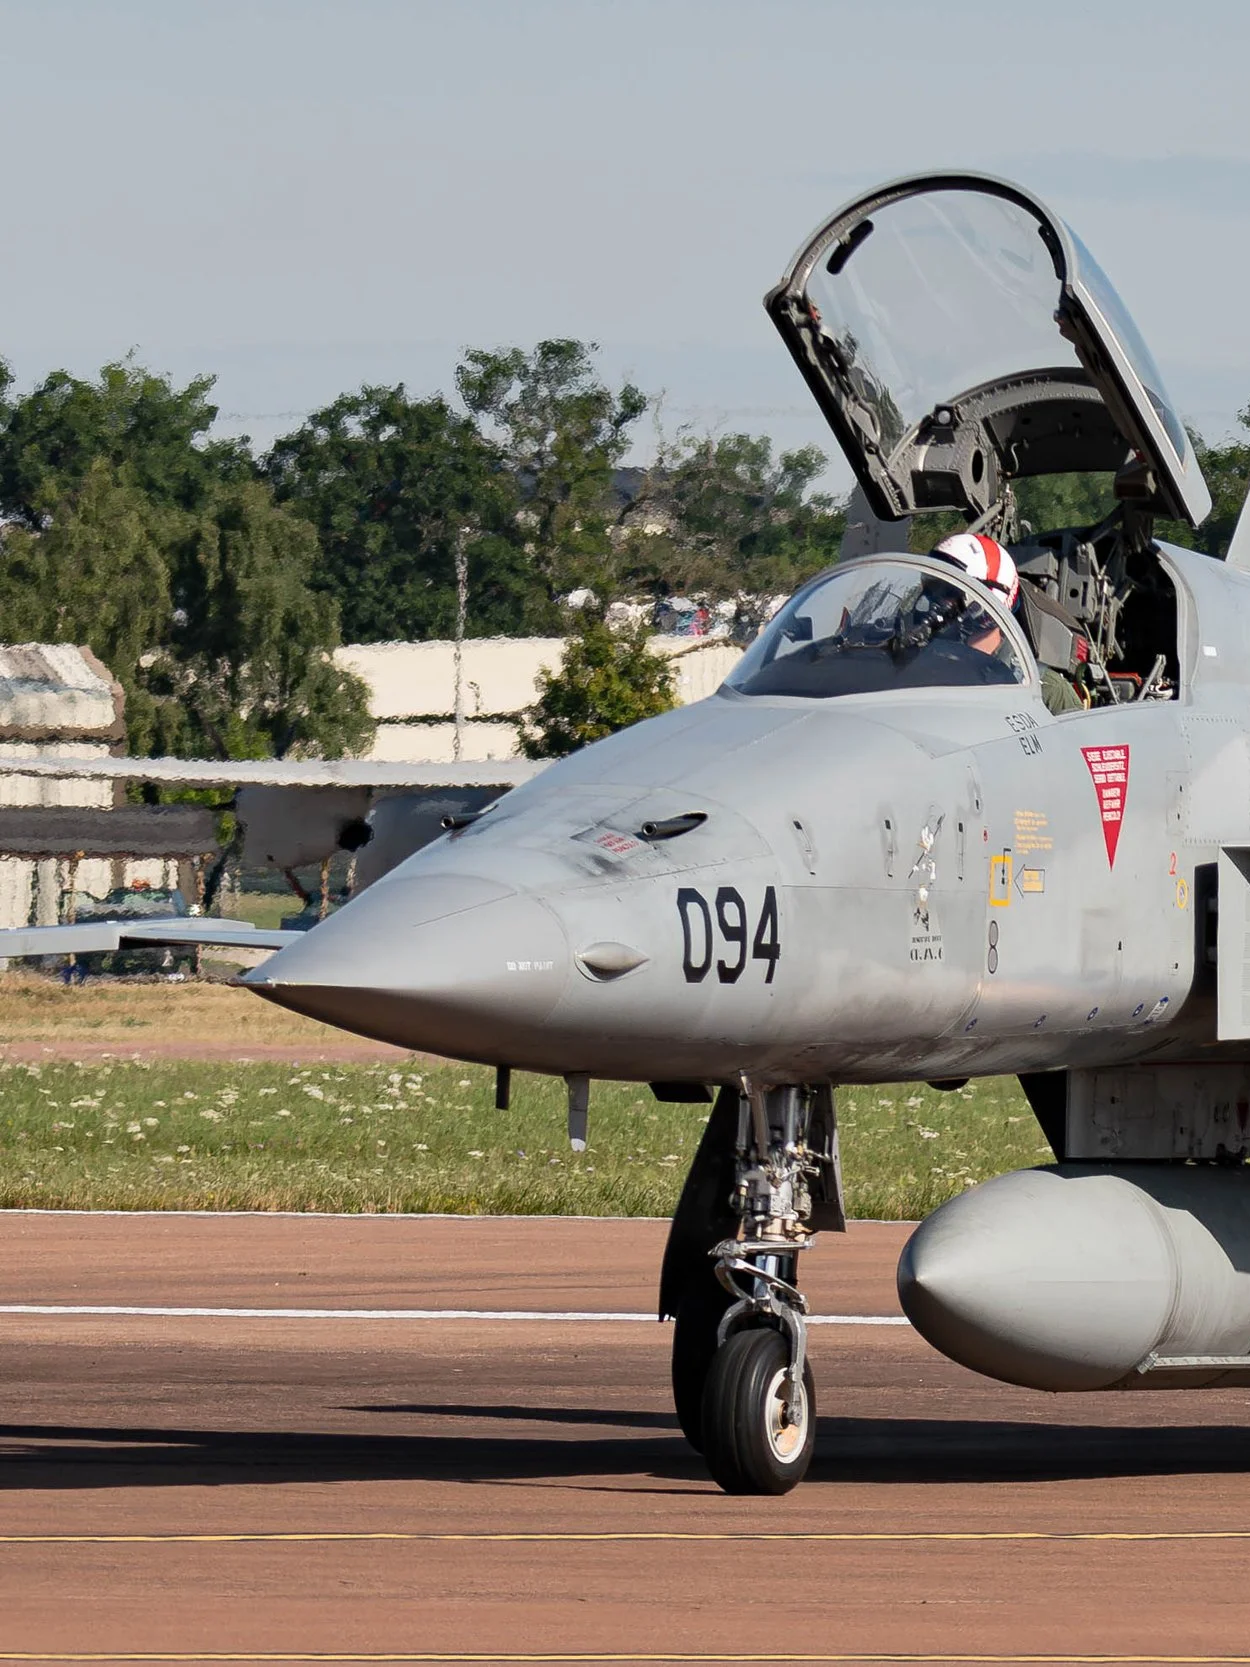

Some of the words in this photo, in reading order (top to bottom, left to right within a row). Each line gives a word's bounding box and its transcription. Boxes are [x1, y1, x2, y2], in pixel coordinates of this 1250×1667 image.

[1004, 711, 1040, 733] ESDA
[1018, 734, 1043, 756] ELM
[676, 885, 781, 984] 094
